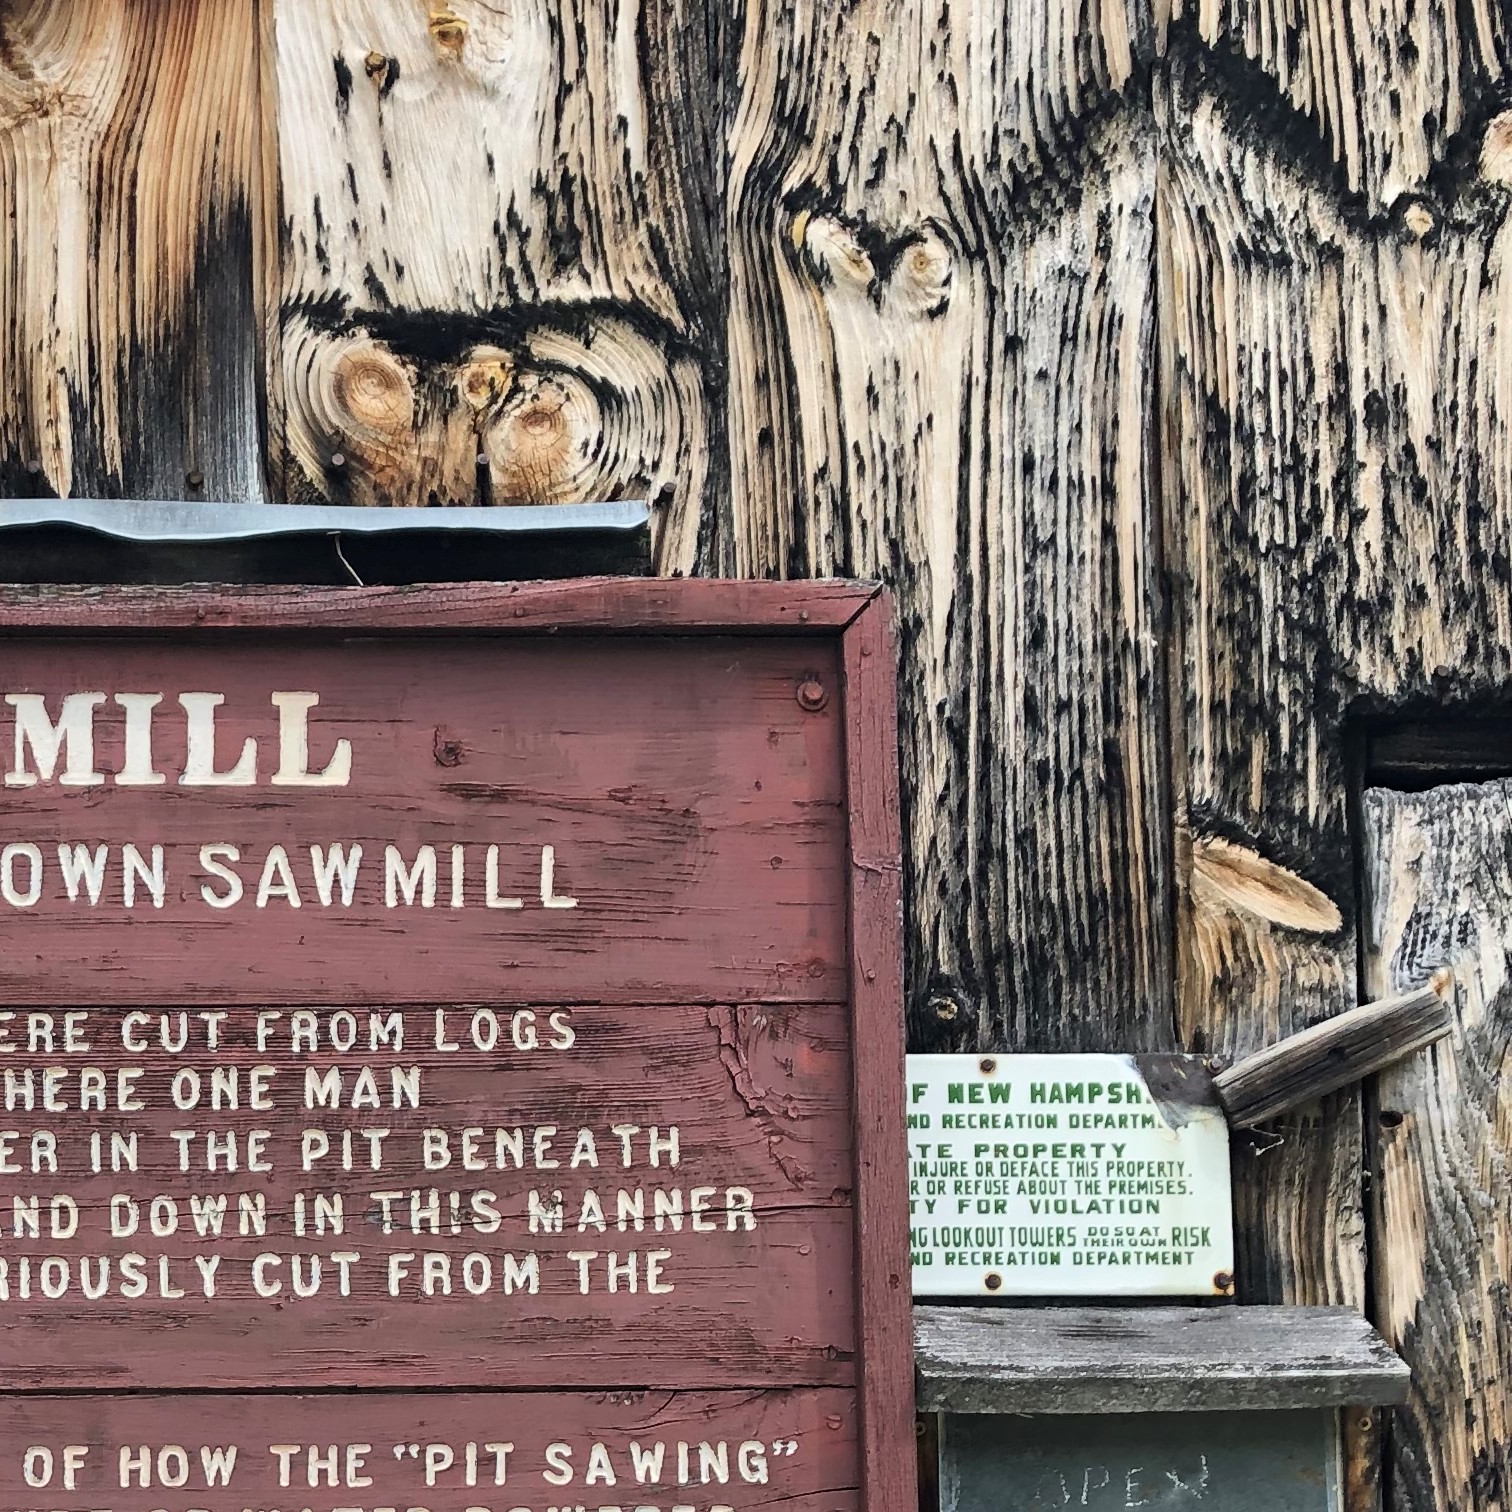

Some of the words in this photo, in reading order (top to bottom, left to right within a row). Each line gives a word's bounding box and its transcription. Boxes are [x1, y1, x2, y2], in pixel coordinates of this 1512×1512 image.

[5, 691, 352, 788] MILL
[199, 842, 579, 909] SAWMILL
[121, 1011, 228, 1052] CUT
[256, 1007, 404, 1054] FROM
[433, 1009, 575, 1052] LOGS
[171, 1065, 277, 1110] ONE
[304, 1065, 425, 1110] MAN
[947, 1082, 1012, 1104] NEW
[1030, 1082, 1154, 1104] HAMPSH
[941, 1114, 1058, 1129] RECREATION
[1068, 1114, 1189, 1129] DEPARTM
[91, 1132, 137, 1173] IN
[170, 1130, 272, 1174] THE
[302, 1128, 390, 1172] PIT
[423, 1125, 679, 1170] BENEATH
[973, 1143, 1128, 1159] PROPERTY
[913, 1161, 969, 1178] INJURE
[975, 1161, 995, 1178] OR
[999, 1161, 1060, 1178] DEFACE
[1066, 1161, 1099, 1178] THIS
[1105, 1161, 1193, 1178] PROPERTY.
[926, 1180, 947, 1196] OR
[953, 1180, 1010, 1196] REFUSE
[1016, 1180, 1068, 1196] ABOUT
[1074, 1180, 1102, 1196] THE
[1108, 1180, 1194, 1196] PREMISES.
[111, 1193, 266, 1237] DOWN
[294, 1193, 343, 1237] IN
[369, 1188, 501, 1234] THIS
[528, 1186, 756, 1234] MANNER
[957, 1200, 1008, 1215] FOR
[1028, 1200, 1161, 1215] VIOLATION
[932, 1226, 1005, 1248] LOOKOUT
[1008, 1227, 1077, 1248] TOWERS
[1082, 1238, 1125, 1248] THEIR
[1128, 1238, 1167, 1248] OWN
[1087, 1227, 1110, 1237] DO
[1138, 1227, 1161, 1237] AT
[1171, 1227, 1212, 1248] RISK
[944, 1252, 1061, 1266] RECREATION
[1072, 1252, 1195, 1266] DEPARTMENT
[252, 1252, 360, 1297] CUT
[388, 1253, 539, 1296] FROM
[567, 1249, 674, 1294] THE
[24, 1446, 88, 1490] OF
[119, 1445, 237, 1488] HOW
[270, 1444, 372, 1487] THE
